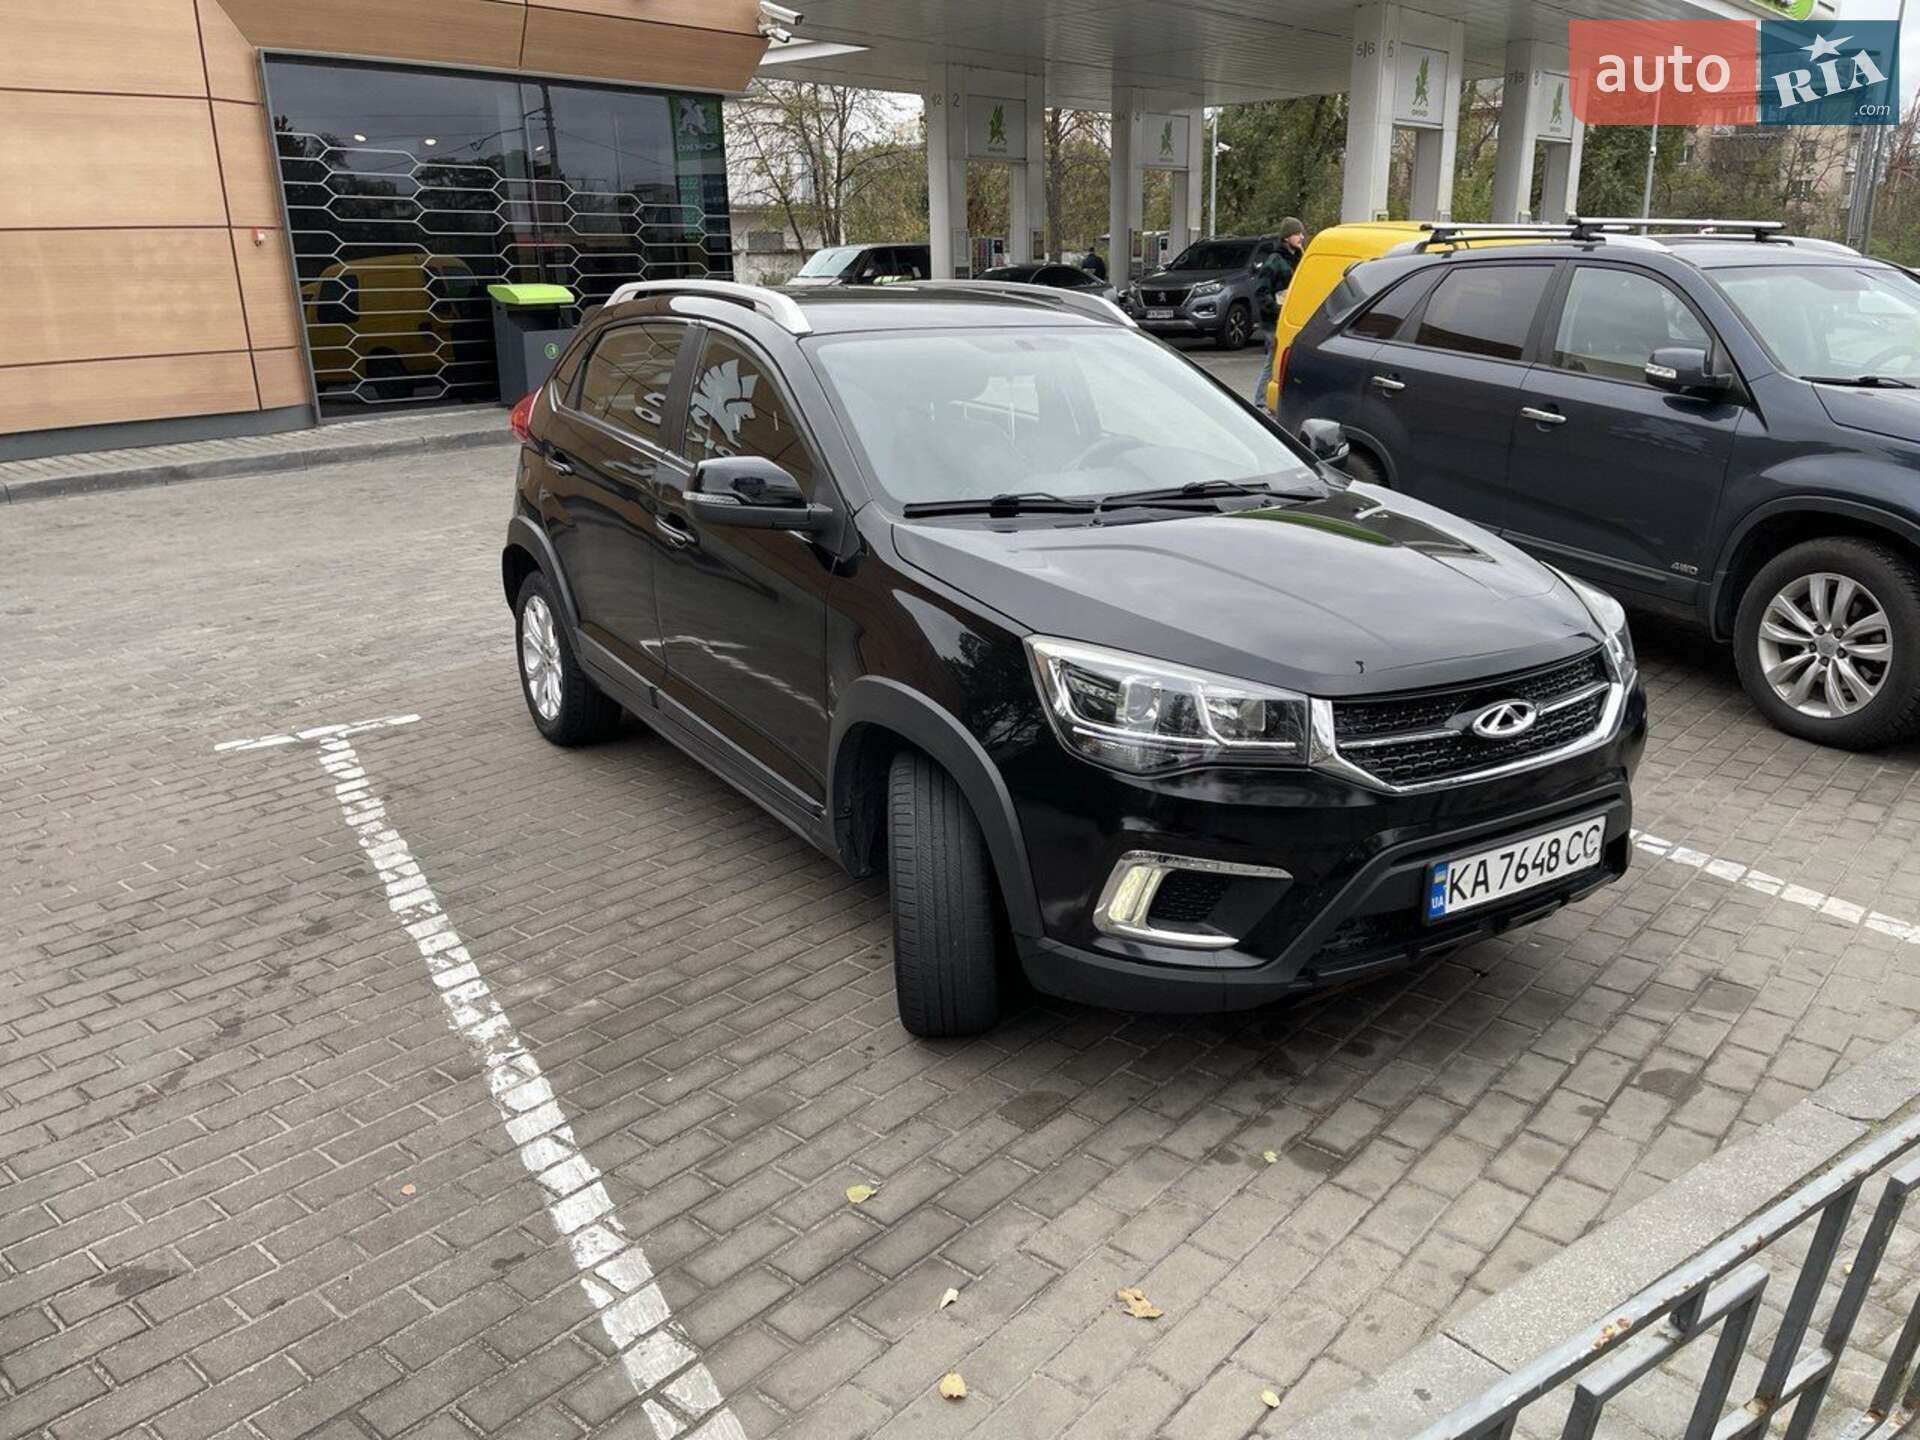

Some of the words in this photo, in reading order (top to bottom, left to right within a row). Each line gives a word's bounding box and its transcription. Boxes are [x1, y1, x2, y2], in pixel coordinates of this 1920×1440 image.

[1449, 859, 1490, 904] KA
[1498, 838, 1561, 890] 7648
[1566, 824, 1600, 865] CC
[1431, 896, 1444, 909] UA
